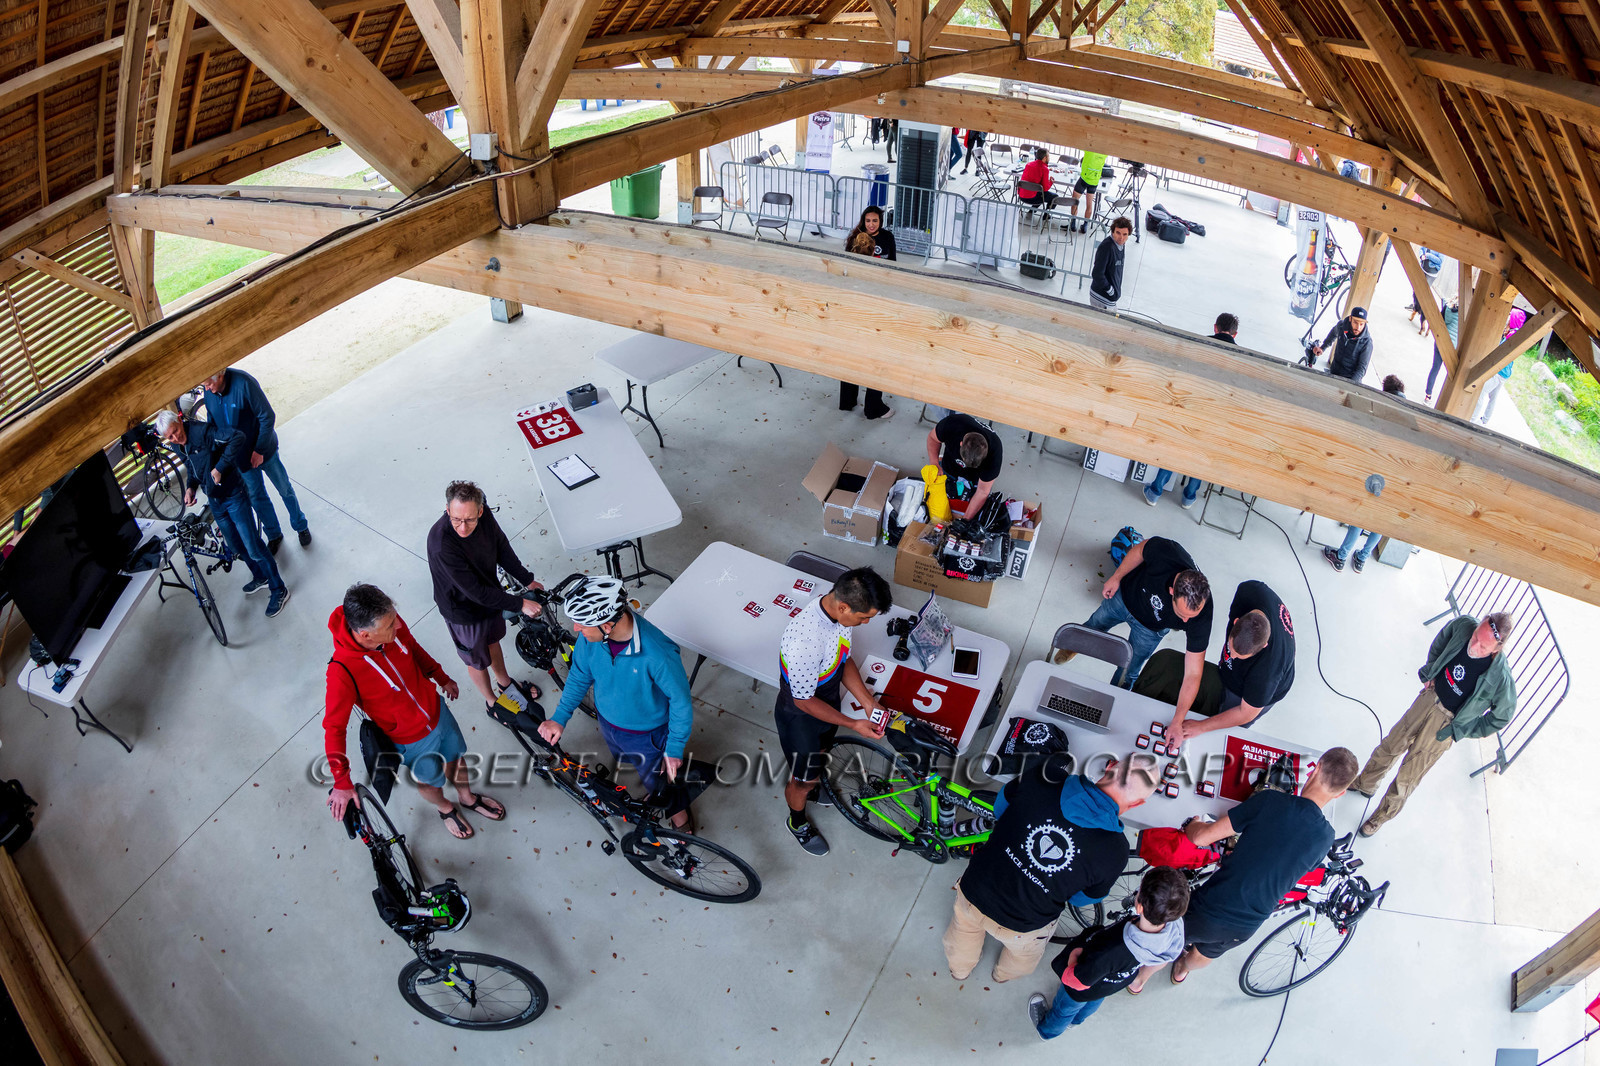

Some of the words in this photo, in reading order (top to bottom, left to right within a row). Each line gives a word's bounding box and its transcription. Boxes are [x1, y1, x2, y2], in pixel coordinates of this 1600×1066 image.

[536, 413, 571, 440] 3B
[1086, 448, 1098, 469] Tacx
[1011, 552, 1026, 576] Tacx
[753, 605, 765, 613] 60
[783, 597, 794, 605] 51
[912, 679, 949, 714] 5
[871, 710, 882, 723] 17
[929, 721, 952, 734] TEST
[1241, 744, 1284, 760] NTERVIEW
[1005, 846, 1024, 868] RACE
[1021, 867, 1050, 894] ANGELS
